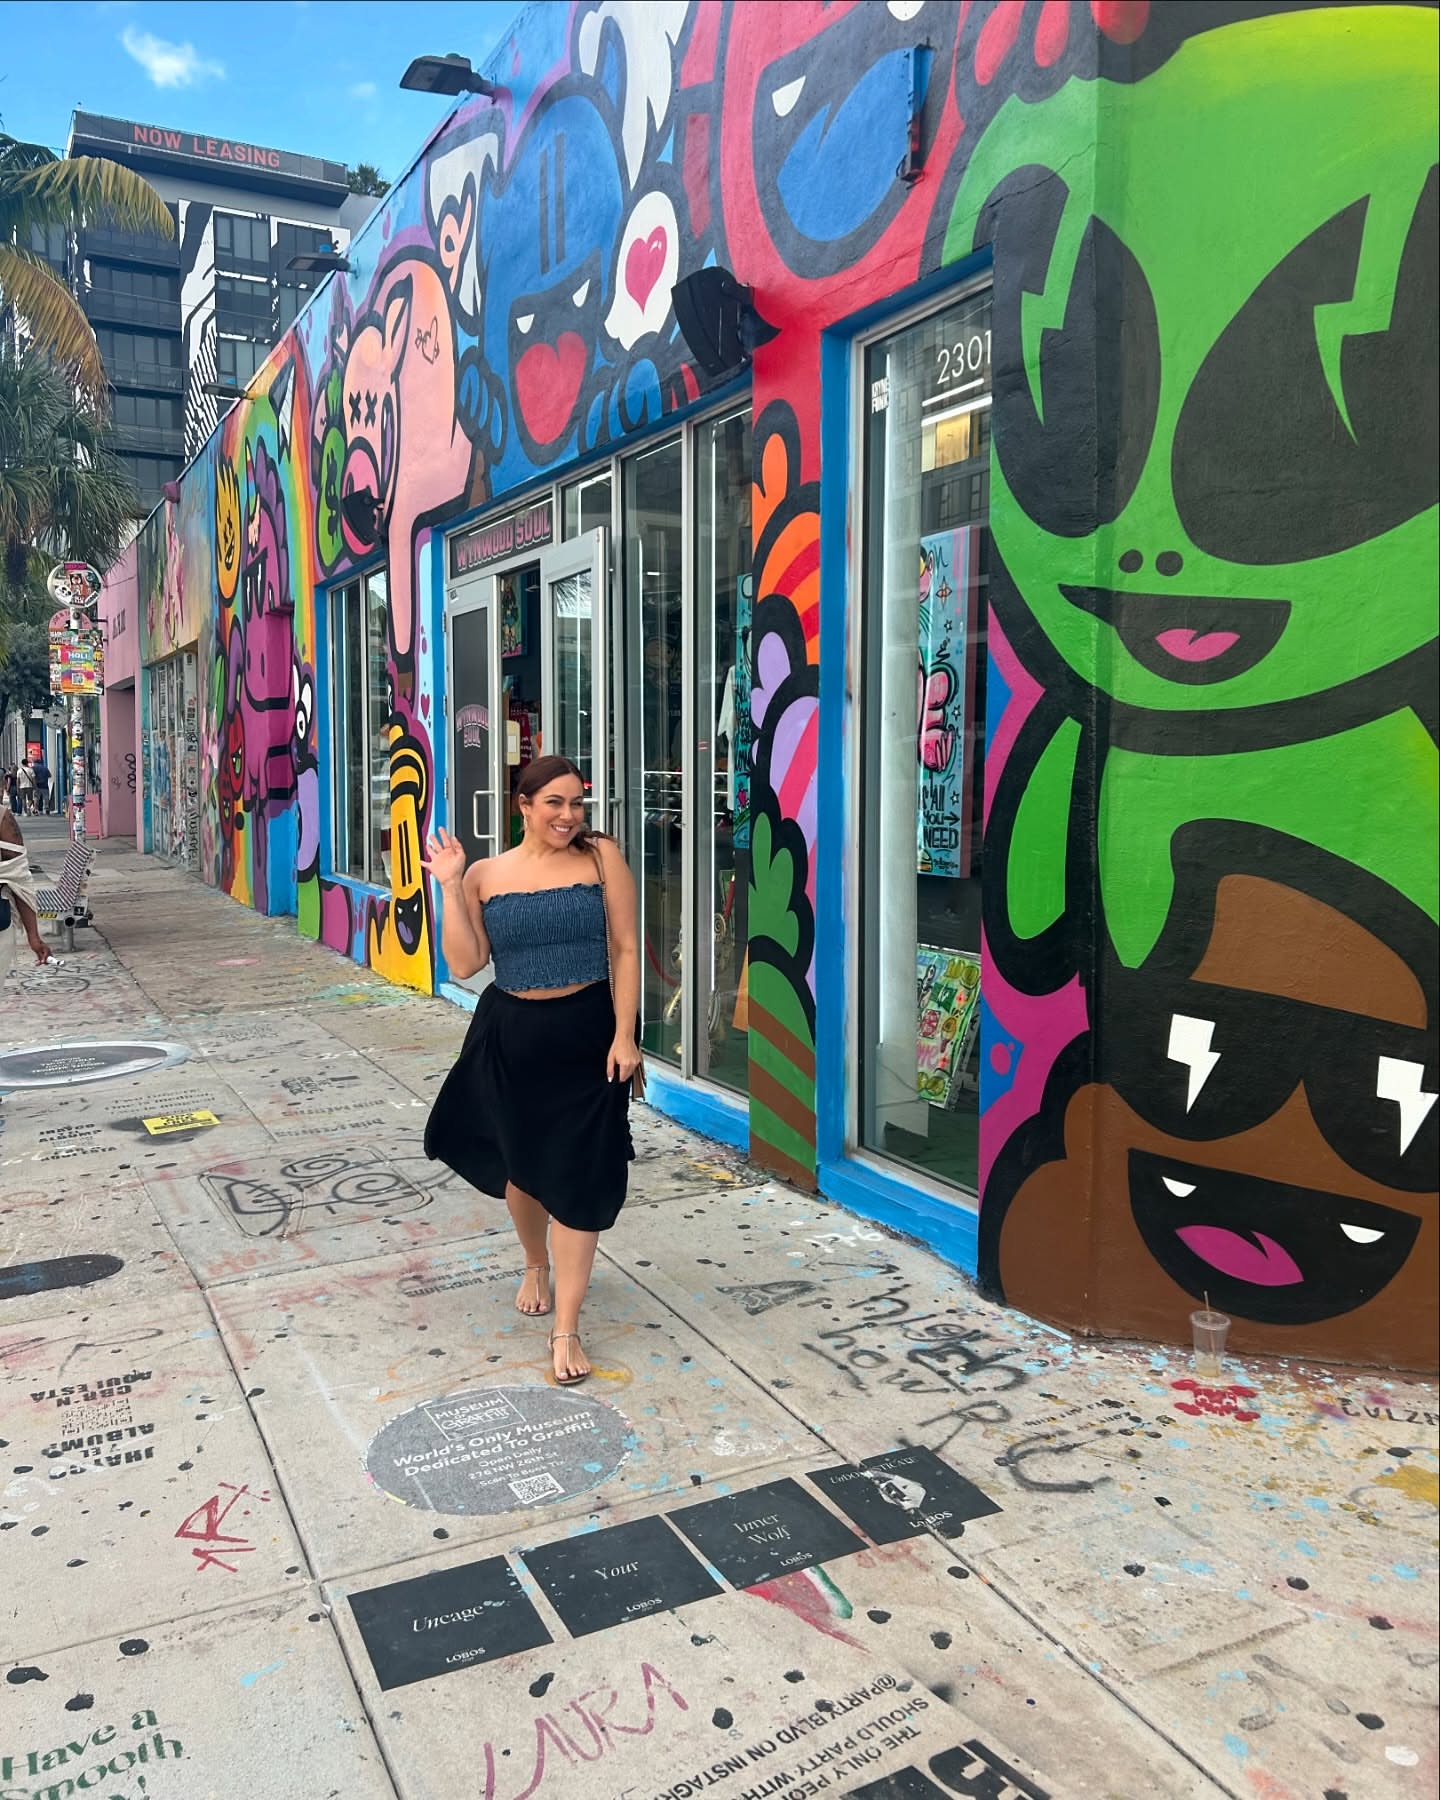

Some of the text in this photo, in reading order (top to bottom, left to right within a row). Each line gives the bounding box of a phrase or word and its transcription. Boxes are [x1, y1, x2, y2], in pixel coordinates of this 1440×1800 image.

[134, 124, 280, 168] NOW LEASING
[937, 329, 992, 384] 2301
[456, 504, 551, 572] WYNWOOD SOUL
[923, 826, 960, 849] NEED
[434, 1397, 505, 1421] MUSEUM
[393, 1411, 591, 1468] World's Only Museum
[404, 1420, 596, 1477] Dedicated To Graffiti
[478, 1446, 543, 1468] Open Daily
[733, 1513, 781, 1535] Inner
[748, 1525, 792, 1546] Wolf
[594, 1560, 640, 1582] Your
[779, 1552, 813, 1568] LOBOS
[412, 1603, 486, 1633] Uncage
[625, 1598, 663, 1613] LOBOS
[446, 1647, 486, 1664] LOBOS
[829, 1673, 898, 1721] @PARTY
[775, 1711, 829, 1745] BLVD
[855, 1697, 930, 1741] SHOULD
[1, 1709, 158, 1781] Have a
[745, 1738, 778, 1763] ON
[884, 1726, 923, 1750] THE
[797, 1739, 858, 1777] PARTY
[835, 1747, 885, 1782] ONLY
[653, 1753, 751, 1800] INSTAGR
